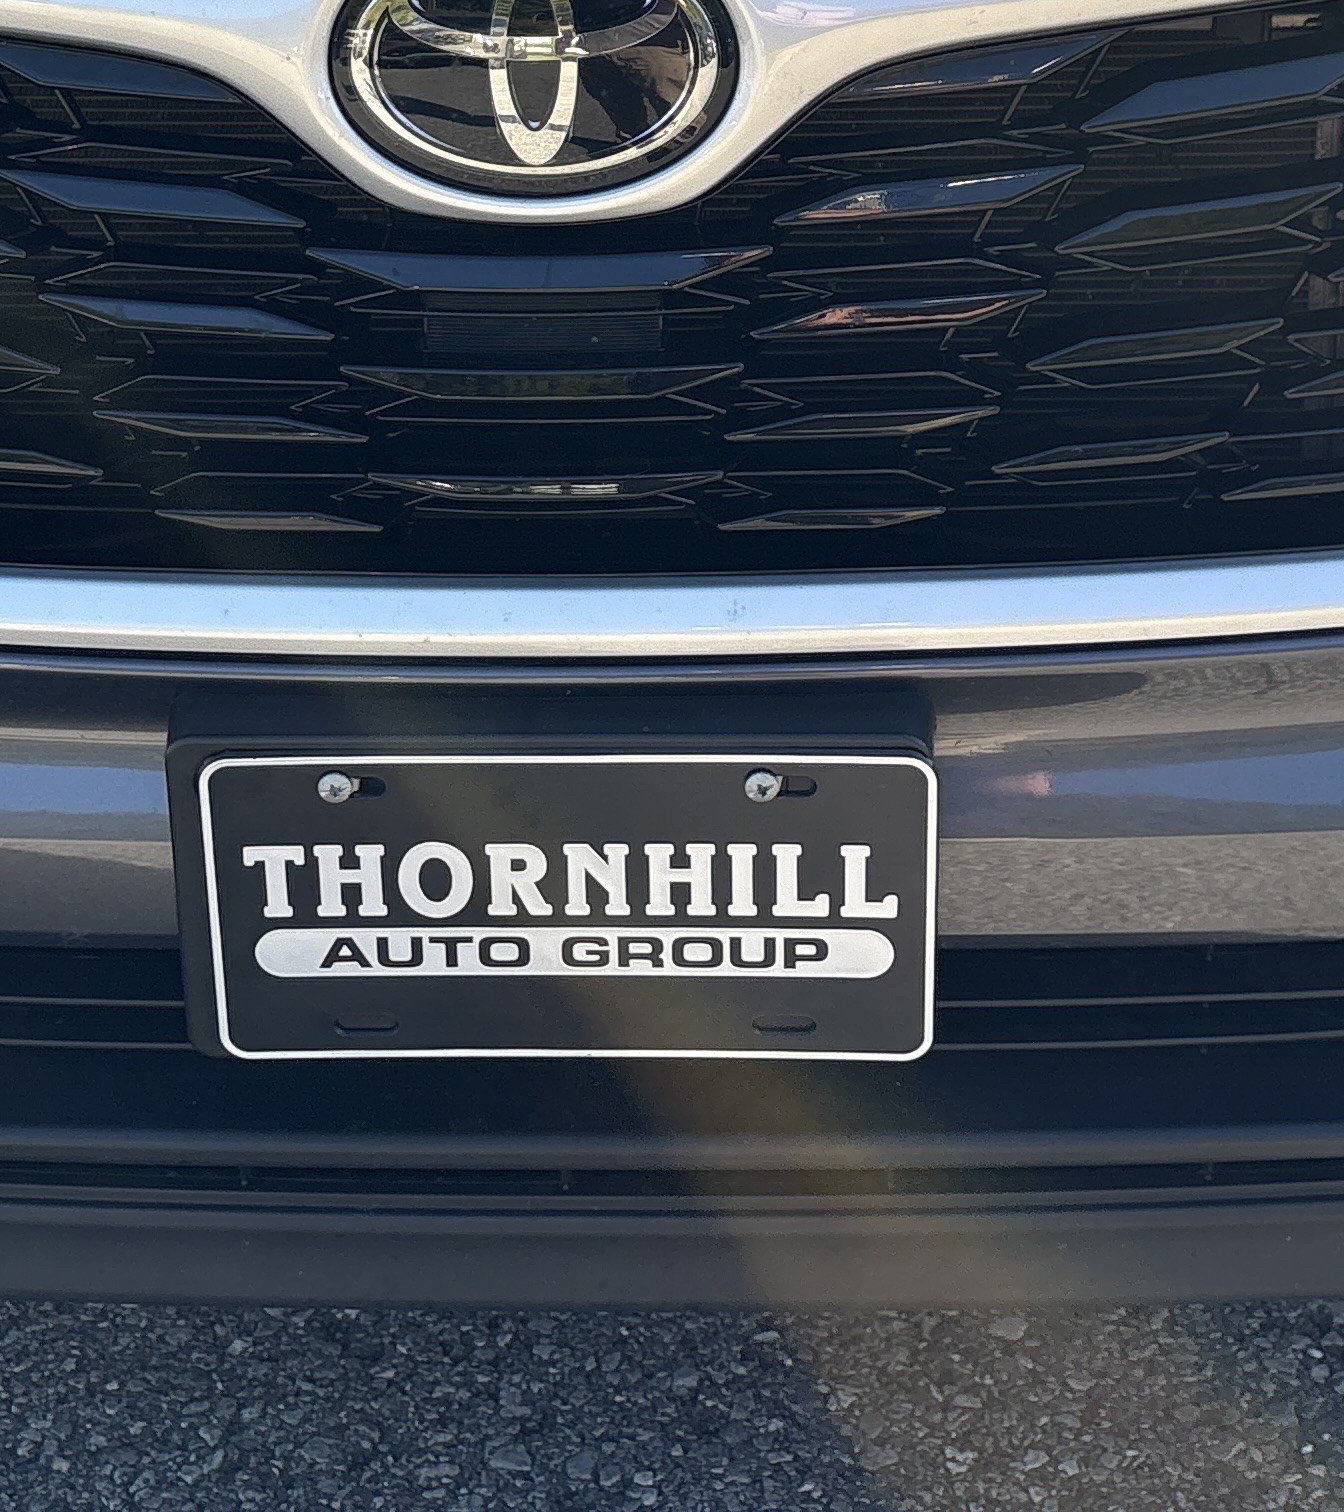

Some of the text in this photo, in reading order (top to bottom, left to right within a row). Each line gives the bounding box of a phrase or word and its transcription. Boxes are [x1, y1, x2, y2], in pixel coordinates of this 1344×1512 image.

[242, 841, 899, 919] THORNHILL
[319, 935, 830, 970] AUTO GROUP
